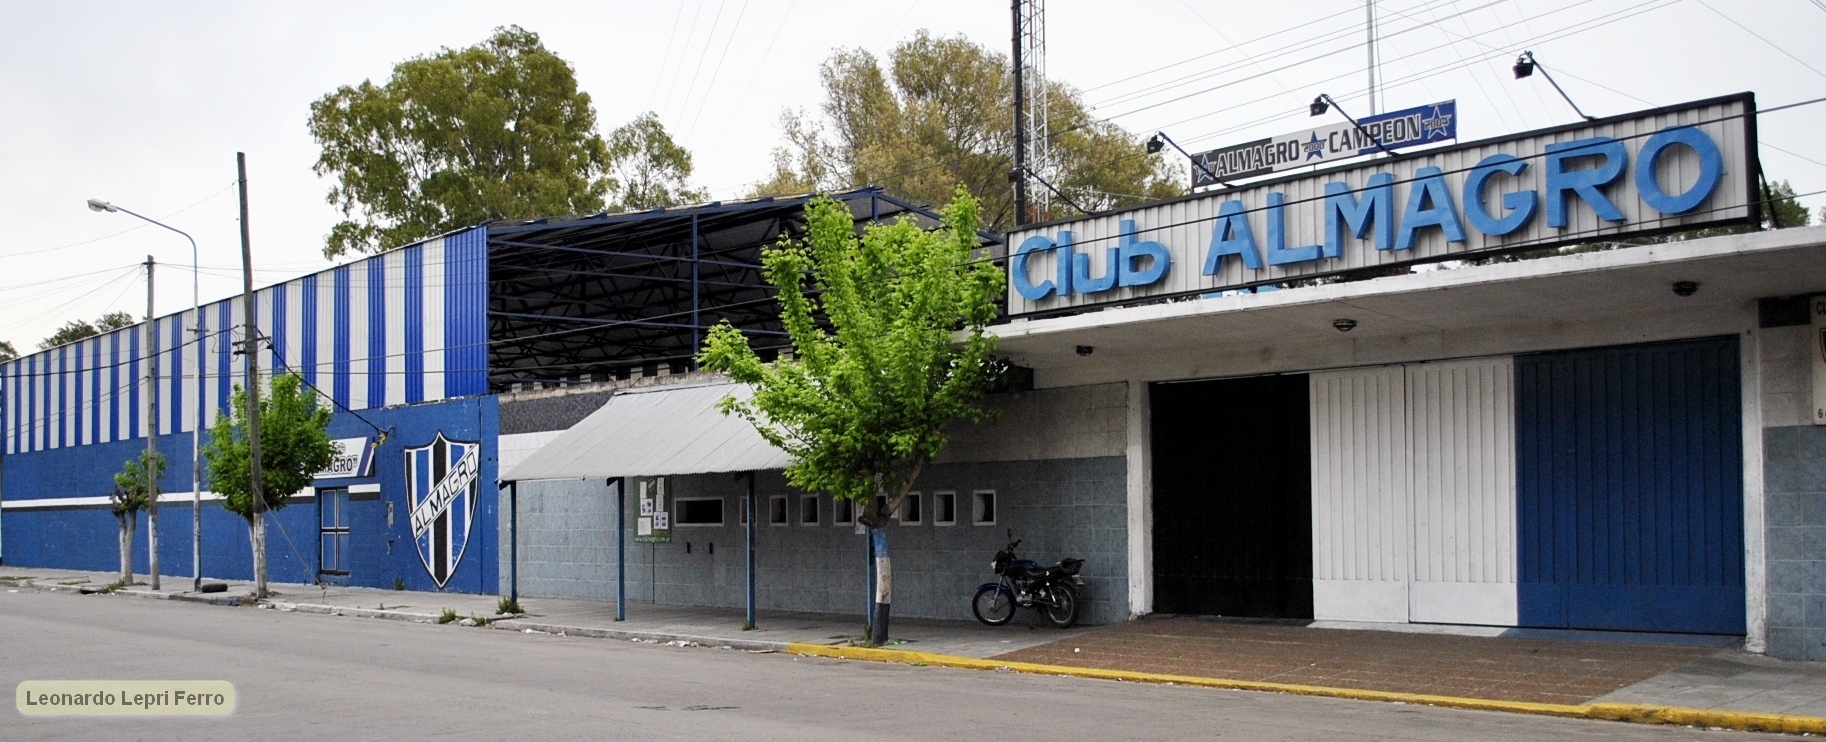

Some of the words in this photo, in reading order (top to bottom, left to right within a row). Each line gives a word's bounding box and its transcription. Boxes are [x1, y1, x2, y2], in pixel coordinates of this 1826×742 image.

[1193, 161, 1216, 176] 18
[1215, 139, 1300, 178] ALMAGRO
[1302, 141, 1325, 153] 2000
[1328, 113, 1422, 154] CAMPEON
[1424, 115, 1450, 130] 2004
[1012, 218, 1171, 301] Club
[1202, 124, 1723, 277] ALMAGRO
[415, 452, 477, 535] ALMAGRO
